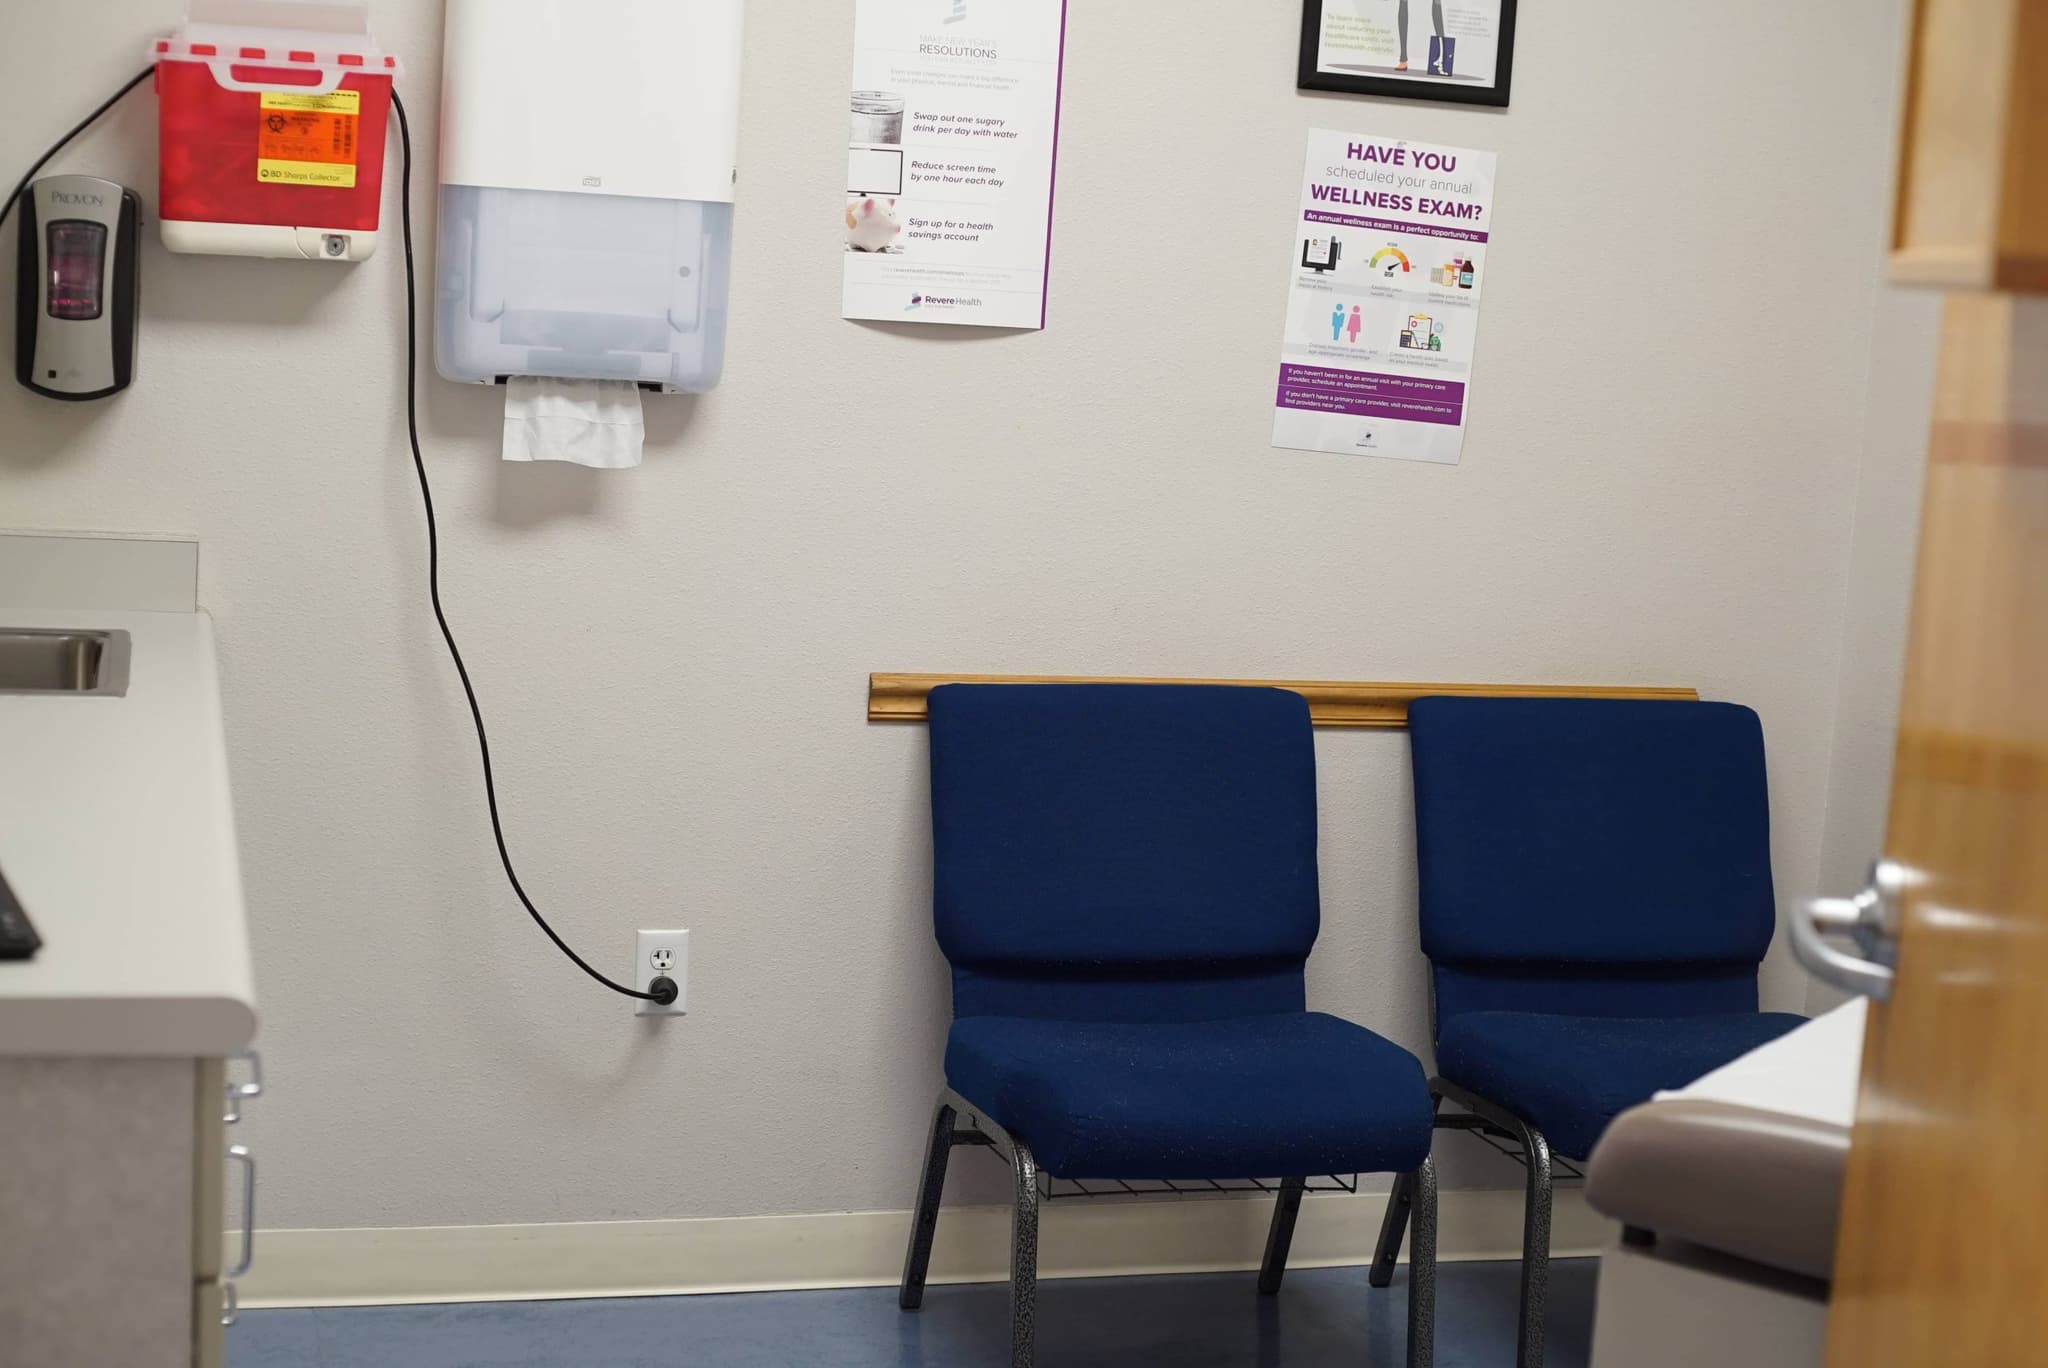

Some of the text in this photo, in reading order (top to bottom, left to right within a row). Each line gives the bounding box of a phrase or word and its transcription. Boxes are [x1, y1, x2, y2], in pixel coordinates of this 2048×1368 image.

[919, 43, 998, 60] RESOLUTIONS
[913, 111, 1006, 127] Swap out one sugary
[912, 124, 1019, 139] drink per day with water
[1347, 142, 1457, 172] HAVE YOU
[911, 160, 997, 174] Reduce screen time
[270, 170, 341, 182] BD Sharps Collector
[910, 173, 922, 183] by
[942, 175, 964, 183] hour
[964, 176, 986, 185] each
[987, 178, 1005, 188] day
[1326, 164, 1473, 194] scheduled your annual
[51, 191, 105, 207] PROVON
[1311, 183, 1483, 221] WELLNESS EXAM?
[908, 218, 929, 228] Sign
[930, 219, 942, 229] up
[944, 220, 957, 228] for
[966, 221, 994, 231] health
[1307, 212, 1317, 220] An
[1318, 214, 1342, 223] annual
[1343, 217, 1373, 227] wellness
[1406, 225, 1431, 235] perfect
[1431, 228, 1470, 240] opportunity
[908, 231, 980, 242] savings account
[1415, 382, 1434, 390] primary
[1296, 400, 1320, 408] providers
[1334, 396, 1354, 404] primary
